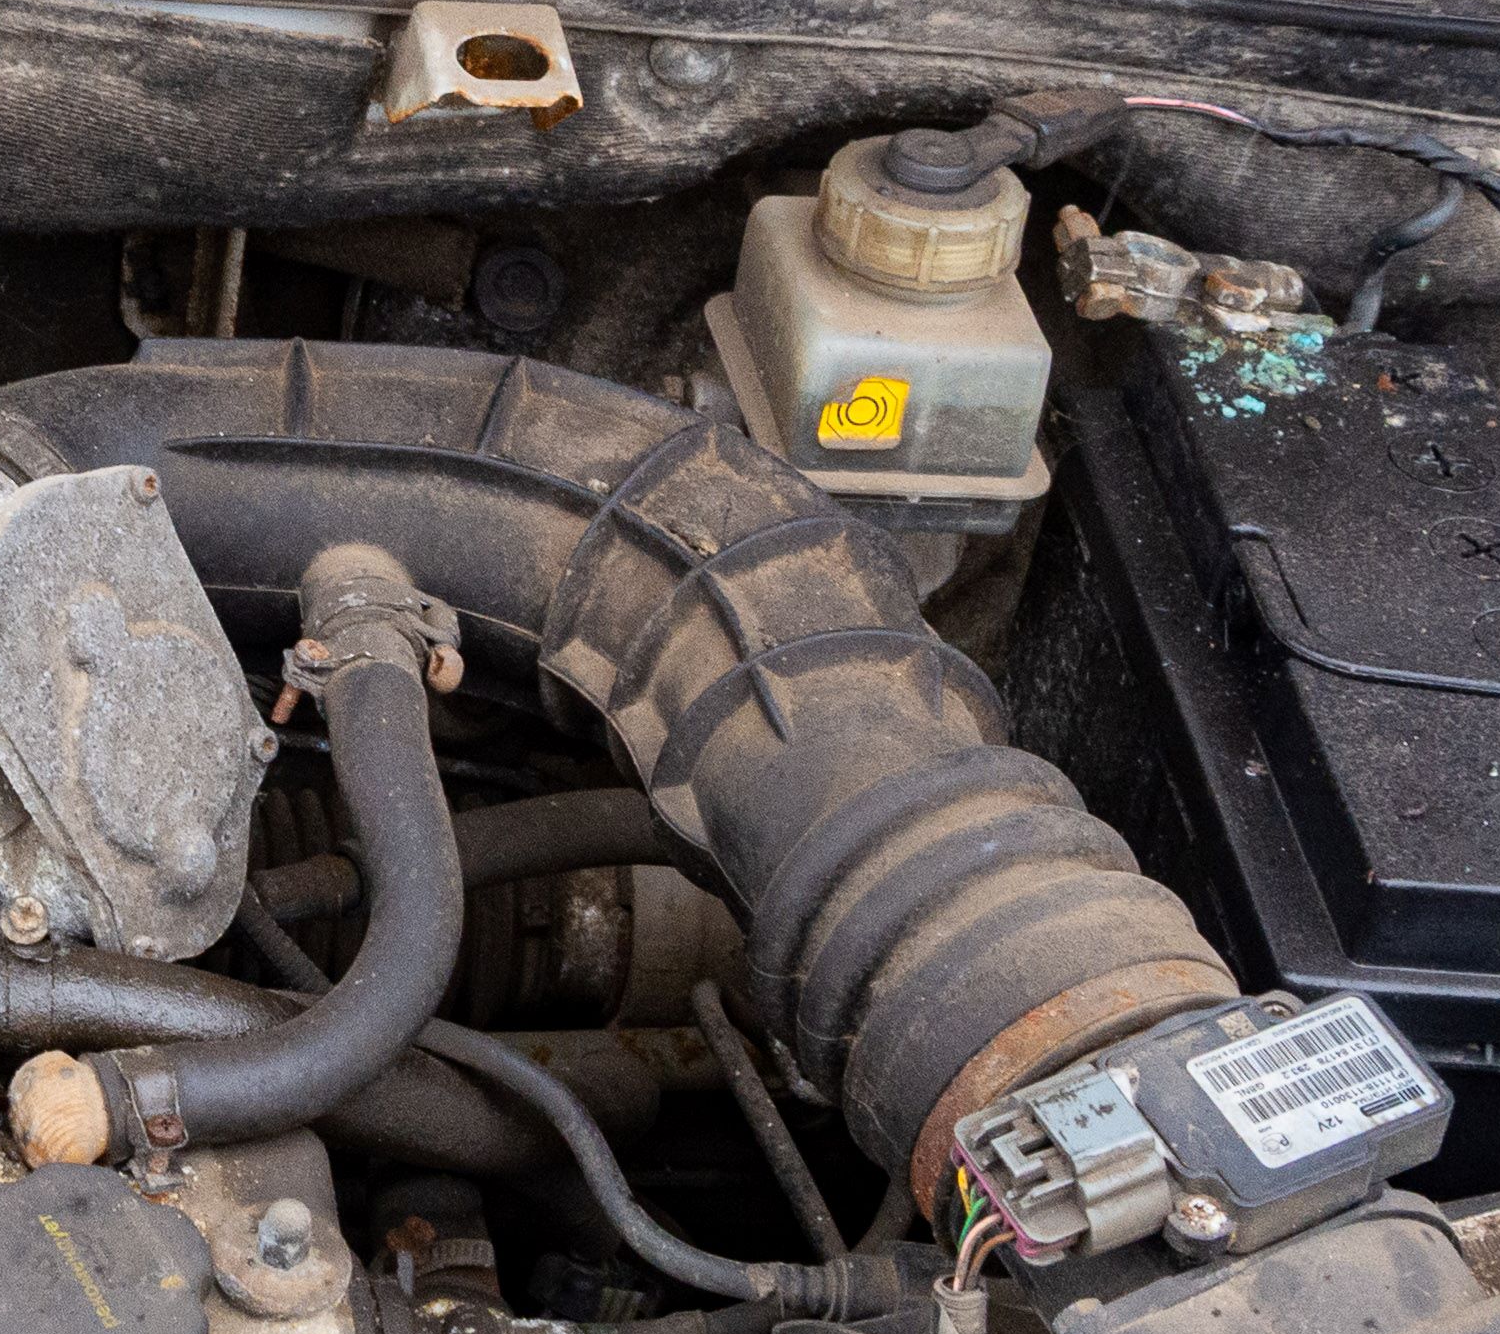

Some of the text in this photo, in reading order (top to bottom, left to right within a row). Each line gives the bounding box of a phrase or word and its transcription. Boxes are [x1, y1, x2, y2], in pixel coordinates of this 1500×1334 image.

[1318, 1074, 1392, 1110] 1118-1130010
[1350, 1076, 1416, 1107] НПП ИТЭЛМА
[1313, 1113, 1345, 1133] 12V
[38, 1213, 121, 1329] рекомендует
